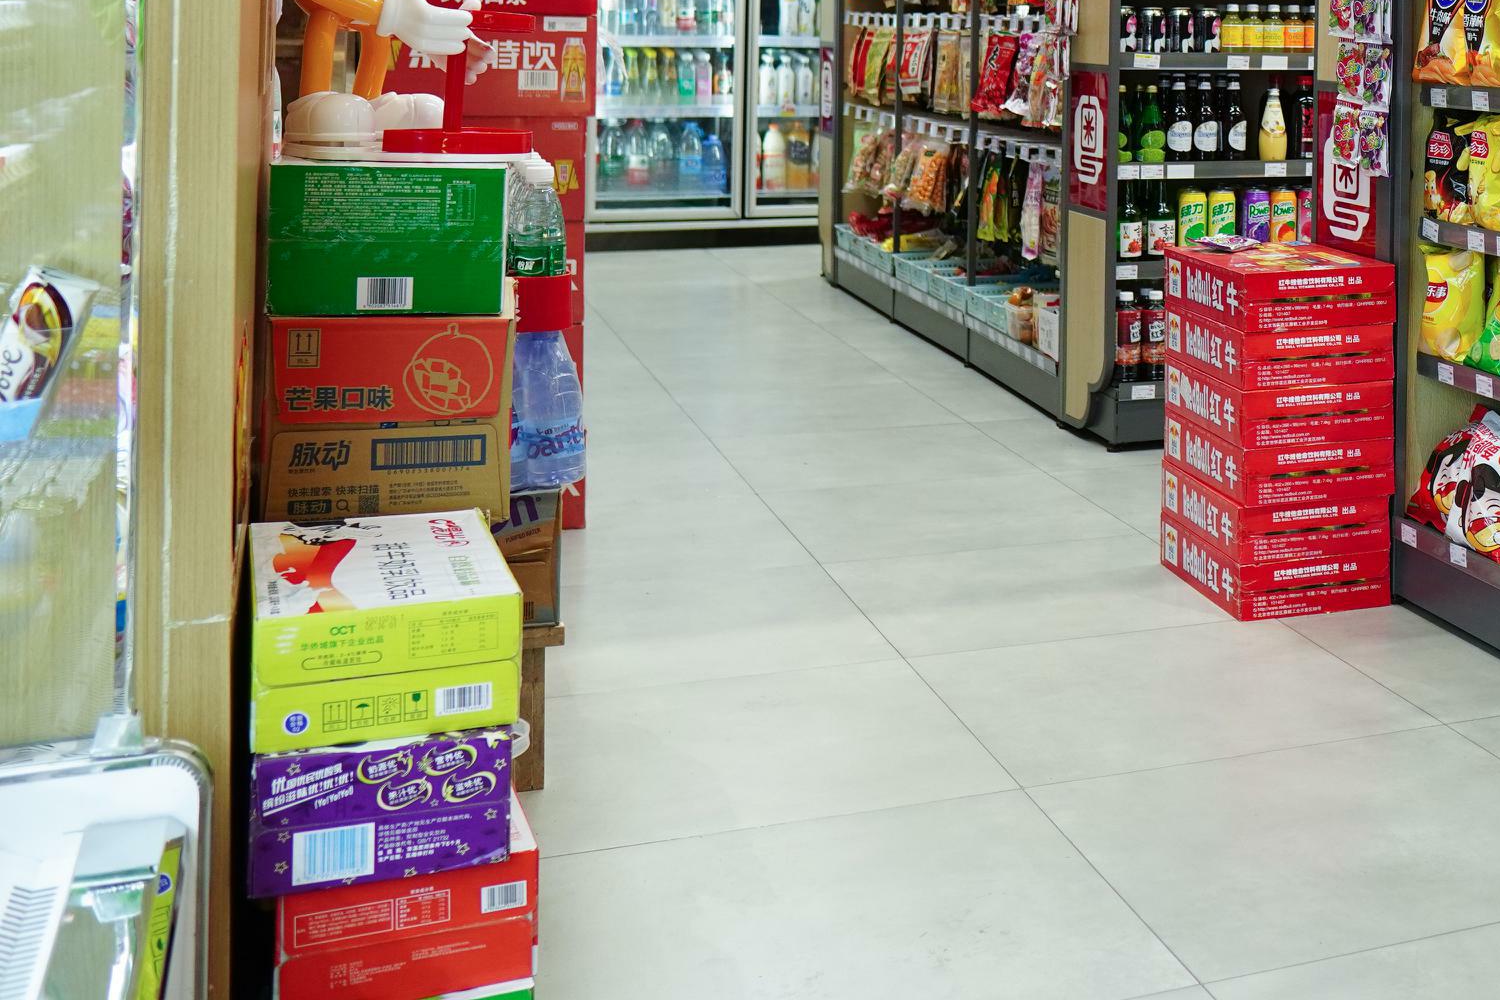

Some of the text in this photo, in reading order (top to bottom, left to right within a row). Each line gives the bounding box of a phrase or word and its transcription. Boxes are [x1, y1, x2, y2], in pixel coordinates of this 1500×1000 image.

[1429, 8, 1452, 25] 牛肉味
[1348, 276, 1363, 286] 出品
[1186, 266, 1239, 316] RedBull 红牛
[1345, 334, 1361, 344] 出品
[1186, 321, 1210, 363] RedBull
[1210, 333, 1237, 375] 红牛
[284, 386, 394, 411] 芒果口味
[1346, 391, 1361, 401] 出品
[1209, 394, 1236, 433] 红牛
[289, 440, 351, 472] 脉动
[1186, 430, 1238, 490] RedBull 红牛
[1347, 448, 1362, 458] 出品
[288, 484, 380, 497] 快来搜索 快来扫描
[292, 501, 328, 514] 脉动
[1182, 484, 1233, 546] RedBull 红牛
[1342, 505, 1357, 515] 出品
[1182, 537, 1235, 602] RedBull 红牛
[1343, 562, 1358, 572] 出品
[329, 624, 357, 636] OCT
